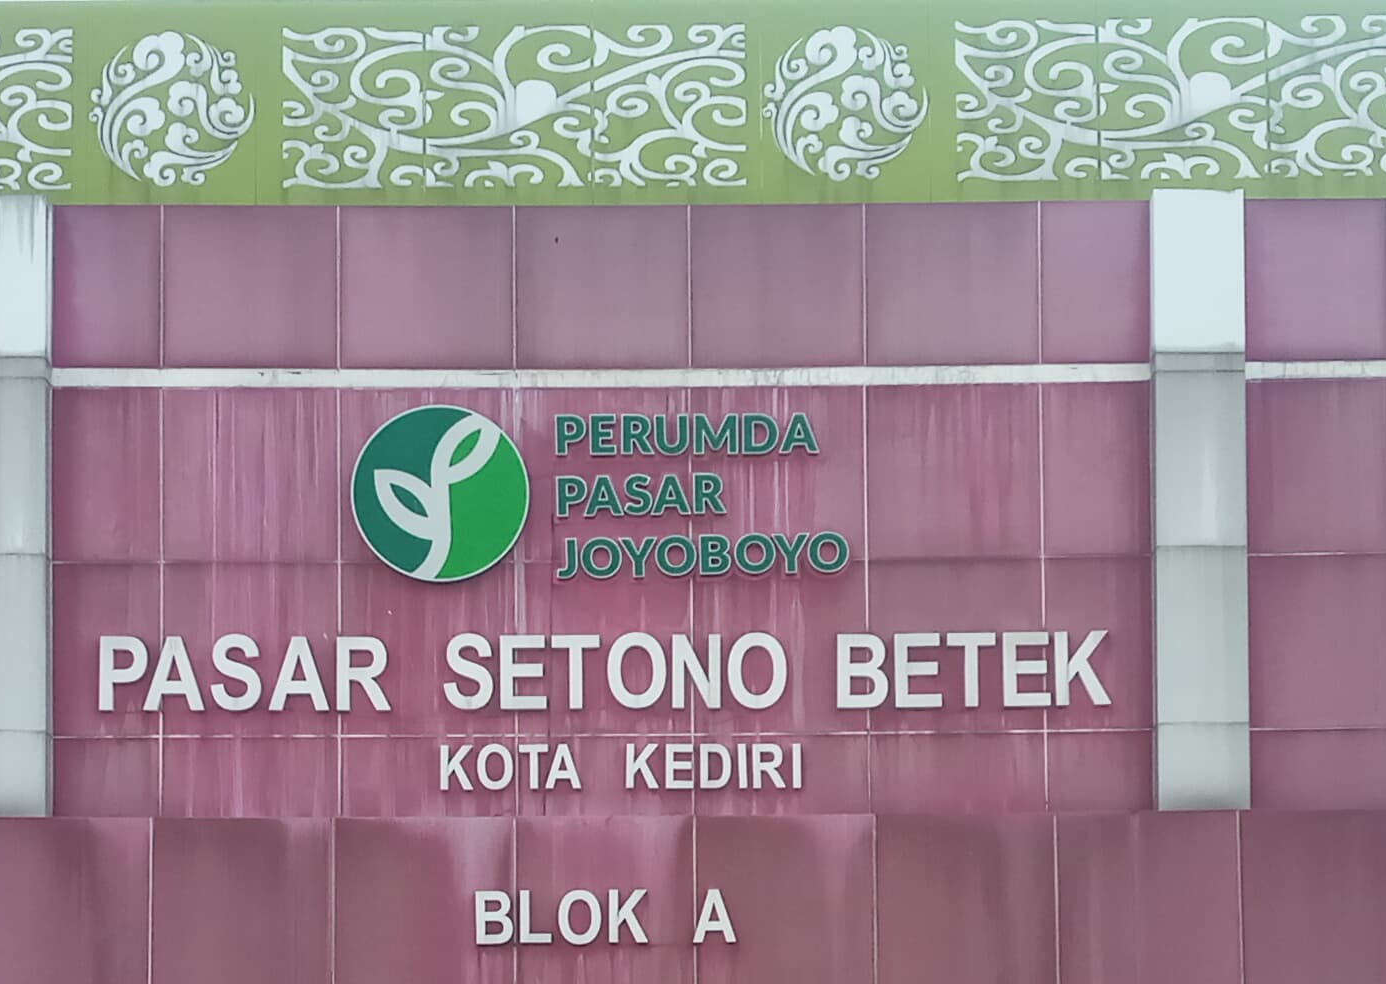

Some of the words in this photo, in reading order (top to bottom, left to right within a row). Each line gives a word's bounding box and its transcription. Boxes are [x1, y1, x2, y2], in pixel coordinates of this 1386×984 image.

[554, 413, 819, 455] PERUMDA
[556, 474, 727, 518] PASAR
[556, 531, 850, 580] JOYOBOYO
[98, 634, 391, 714] PASAR
[442, 631, 789, 711] SETONO
[835, 629, 1112, 709] BETEK
[438, 744, 582, 792] KOTA
[625, 742, 805, 790] KEDIRI
[473, 888, 649, 946] BLOK
[693, 888, 738, 945] A
